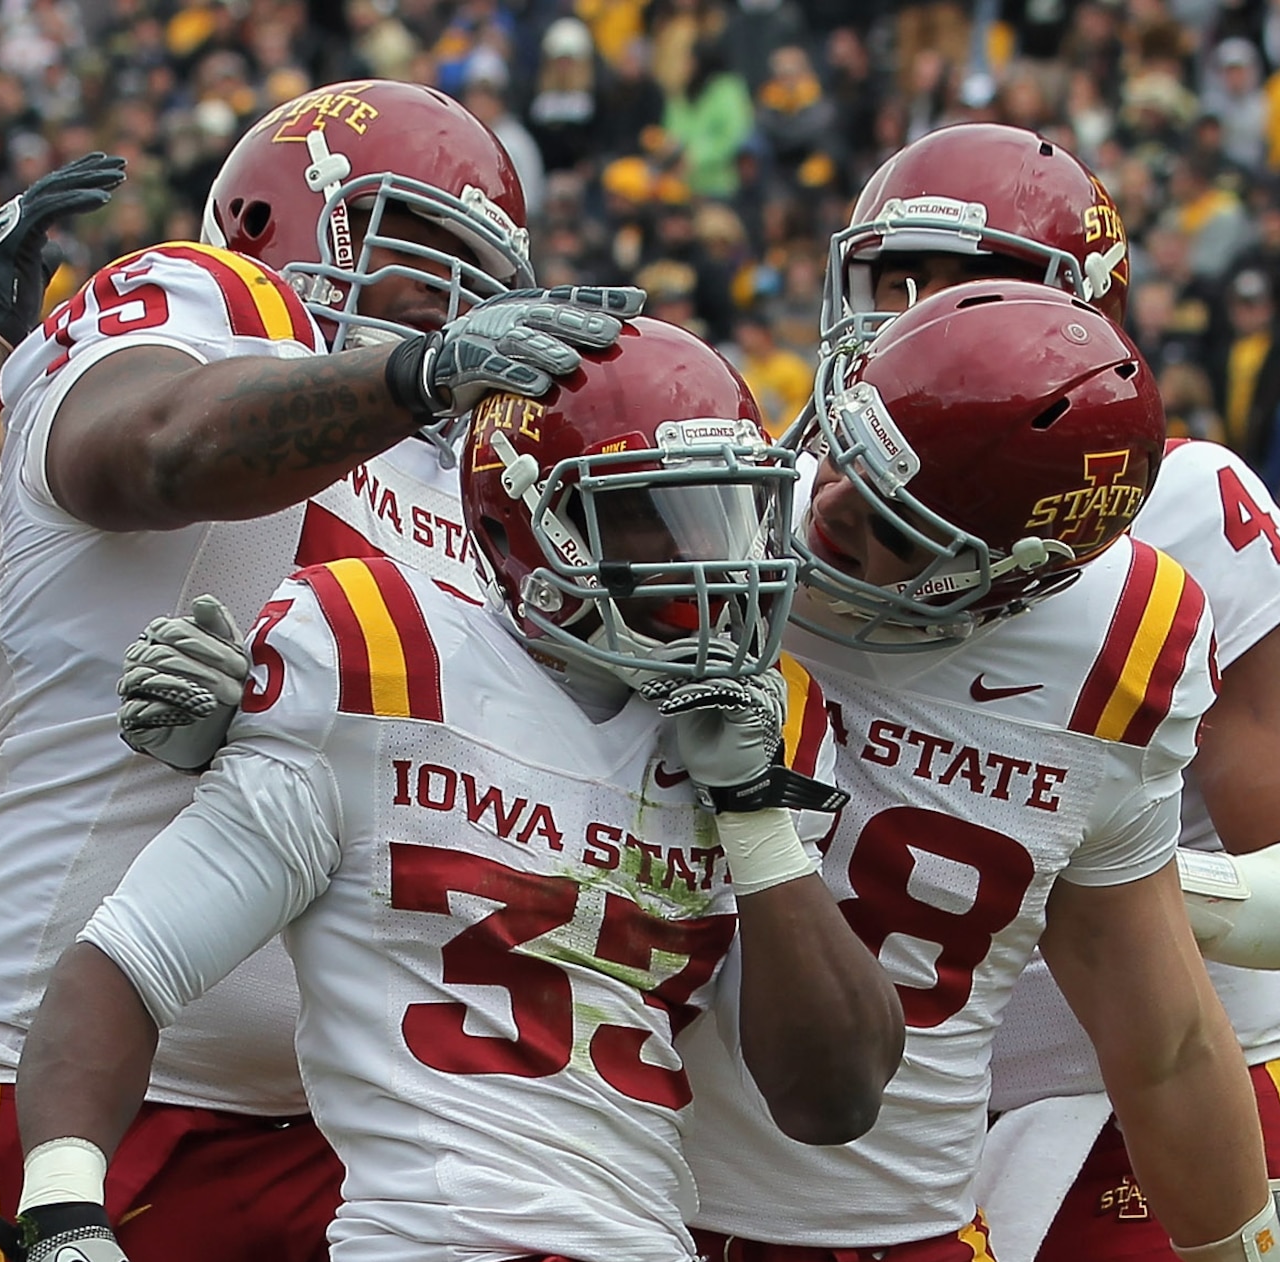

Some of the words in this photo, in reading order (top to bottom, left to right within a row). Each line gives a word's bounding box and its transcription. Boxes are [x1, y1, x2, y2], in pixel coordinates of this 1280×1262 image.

[254, 92, 380, 137] STATE
[907, 205, 961, 217] CYCLONES
[1084, 204, 1126, 244] STA
[332, 204, 354, 273] Riddell
[472, 394, 545, 443] TATE
[685, 427, 735, 439] CYCLONES
[865, 407, 899, 456] CYCLONES
[1024, 485, 1143, 529] STATE
[860, 719, 1068, 812] STATE
[392, 759, 564, 851] IOWA
[582, 822, 733, 892] STAT
[818, 805, 1037, 1028] 8
[388, 842, 738, 1111] 33
[1100, 1184, 1144, 1210] STA
